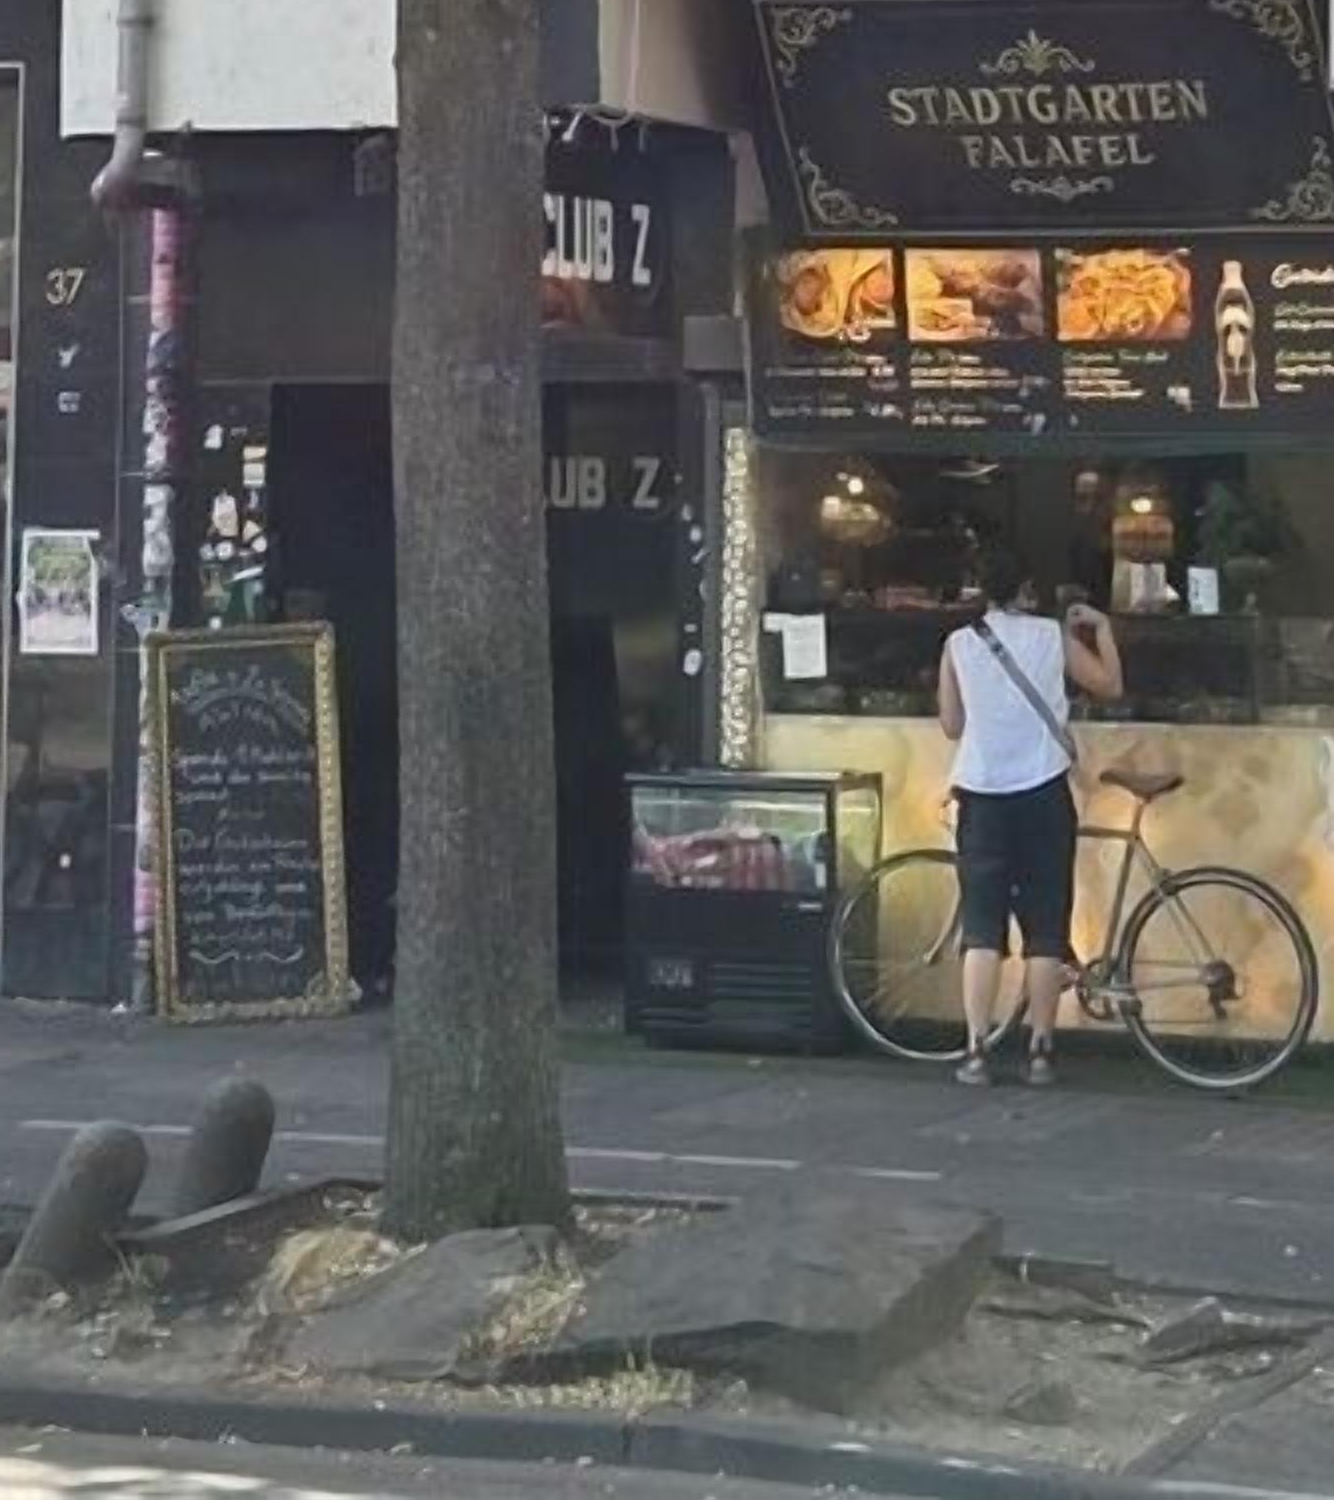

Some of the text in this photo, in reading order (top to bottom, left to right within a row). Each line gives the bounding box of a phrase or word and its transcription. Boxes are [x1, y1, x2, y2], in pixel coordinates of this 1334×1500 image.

[887, 79, 1209, 127] STADTGARTEN
[962, 133, 1156, 169] FALAFEL
[632, 203, 650, 285] Z
[46, 268, 84, 304] 37
[633, 457, 660, 508] Z
